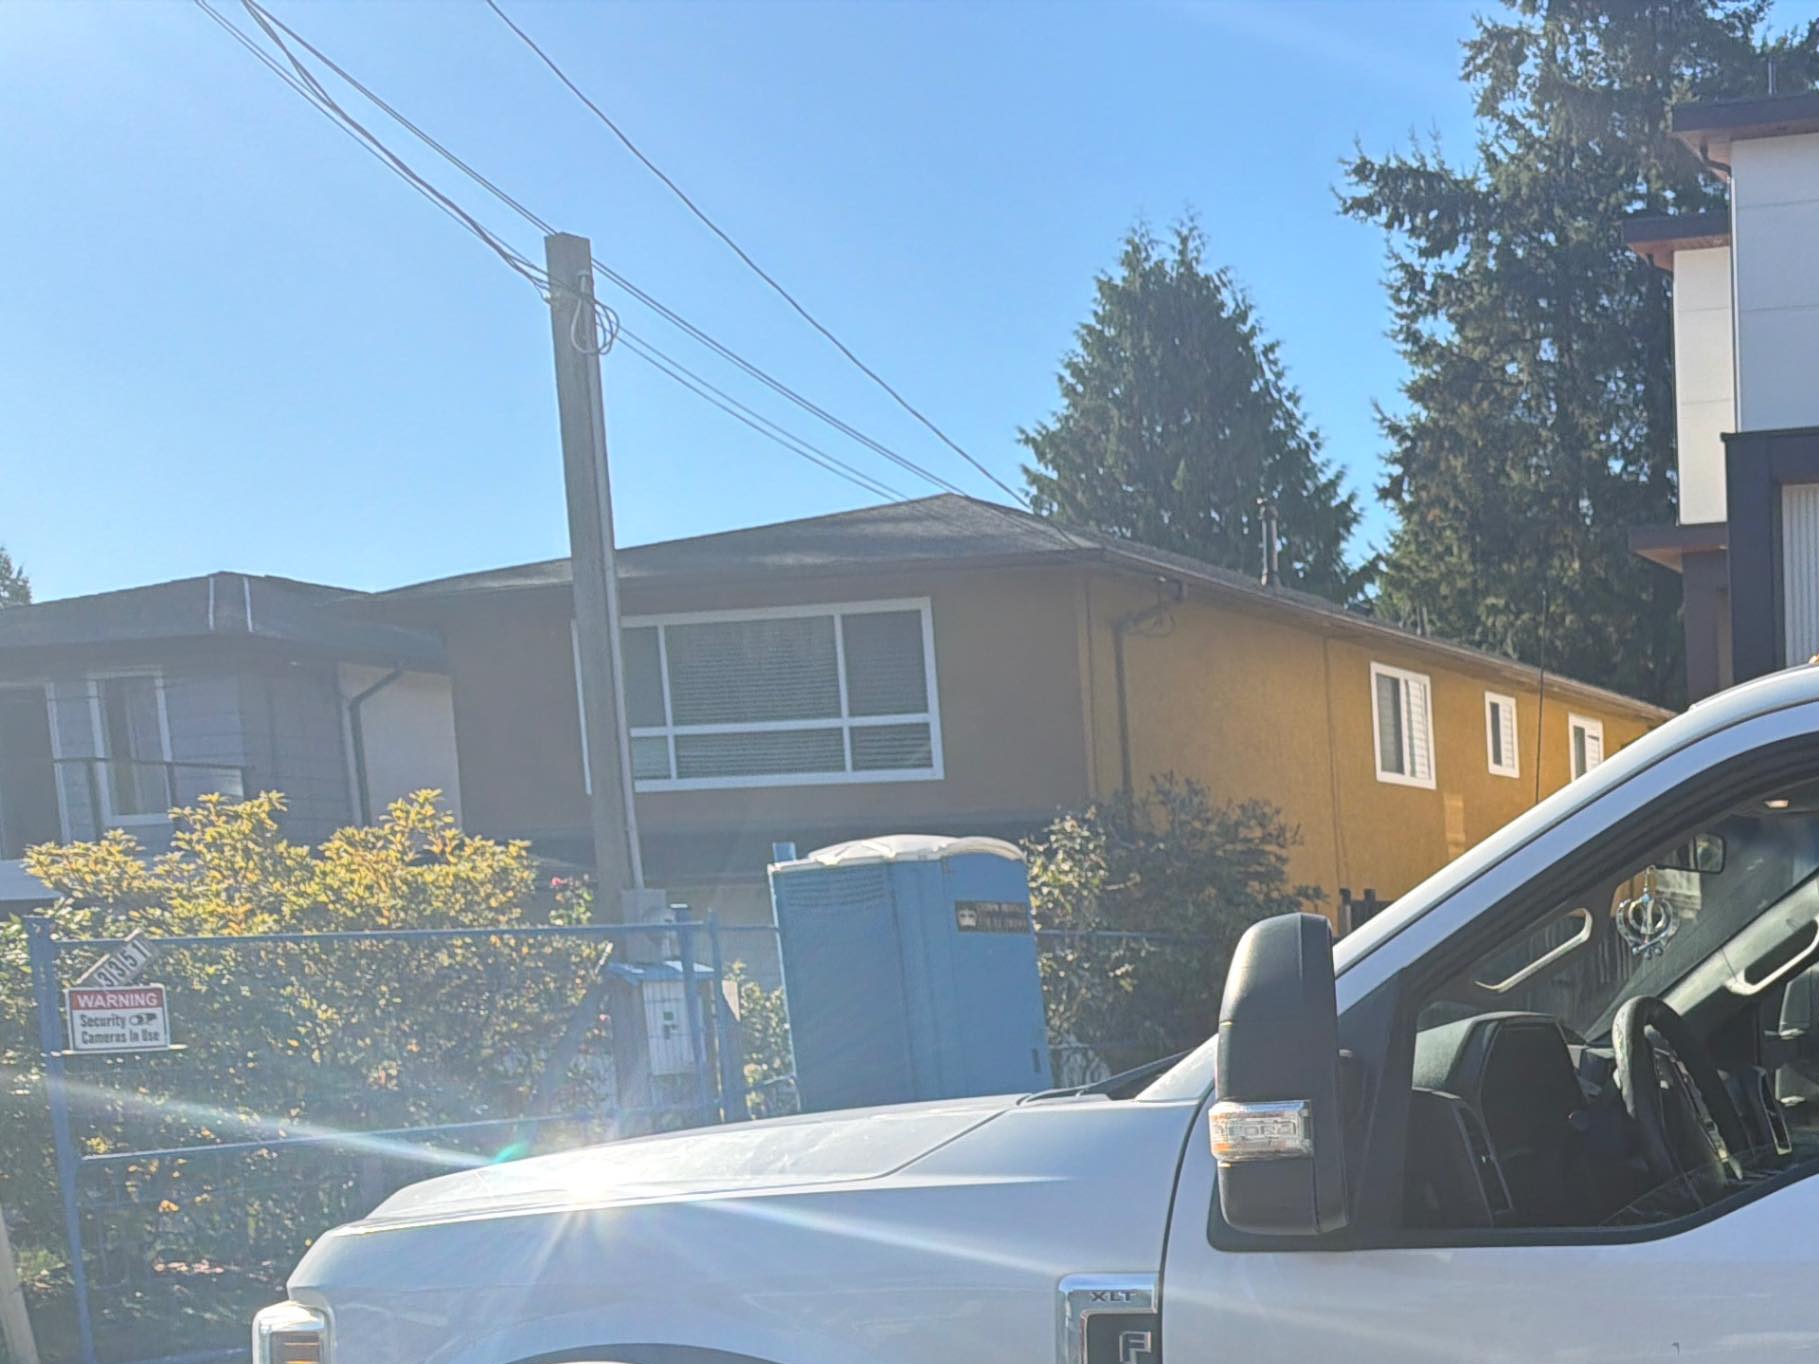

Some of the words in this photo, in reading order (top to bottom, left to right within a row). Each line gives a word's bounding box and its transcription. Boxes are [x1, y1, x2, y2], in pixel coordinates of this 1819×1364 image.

[77, 992, 157, 1008] WARNING
[80, 1014, 126, 1028] Security
[81, 1031, 126, 1044] Cameras
[141, 1029, 160, 1042] Use
[1089, 1290, 1137, 1302] XLT
